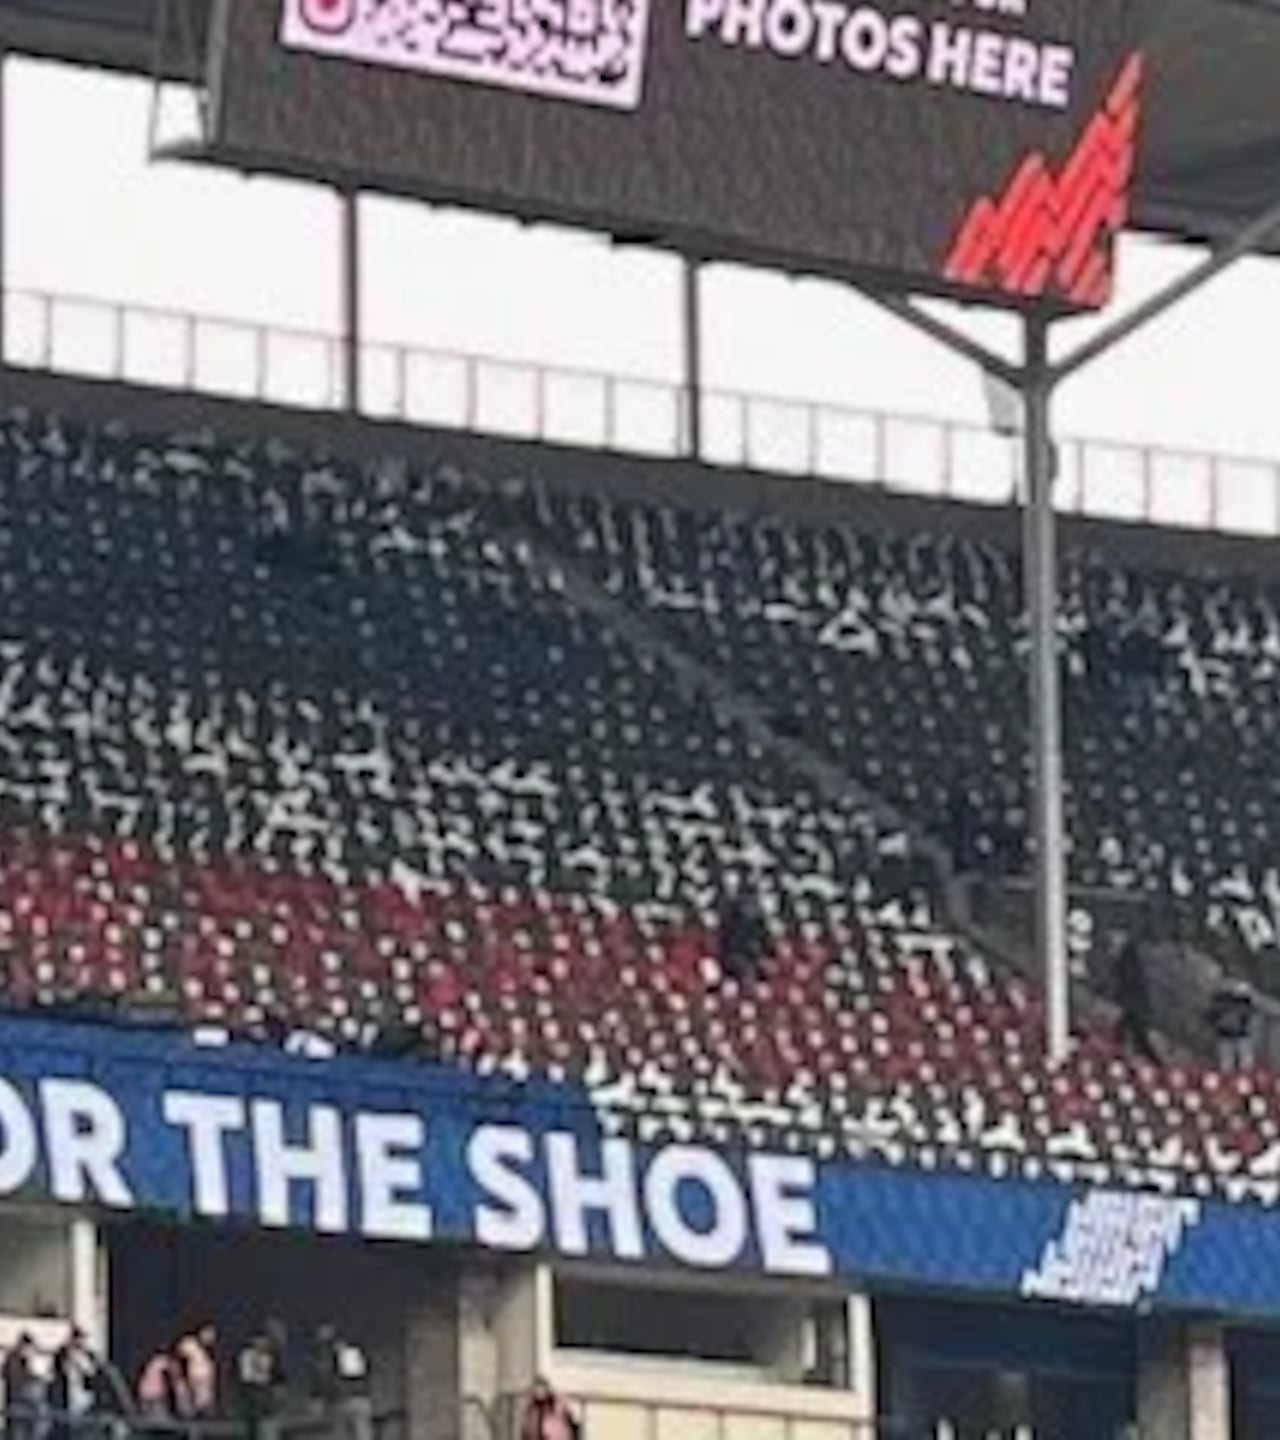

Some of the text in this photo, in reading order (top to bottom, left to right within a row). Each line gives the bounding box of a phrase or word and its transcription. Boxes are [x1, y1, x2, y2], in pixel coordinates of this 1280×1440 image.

[925, 21, 1073, 108] HERE
[162, 1090, 433, 1240] THE
[462, 1120, 833, 1277] SHOE
